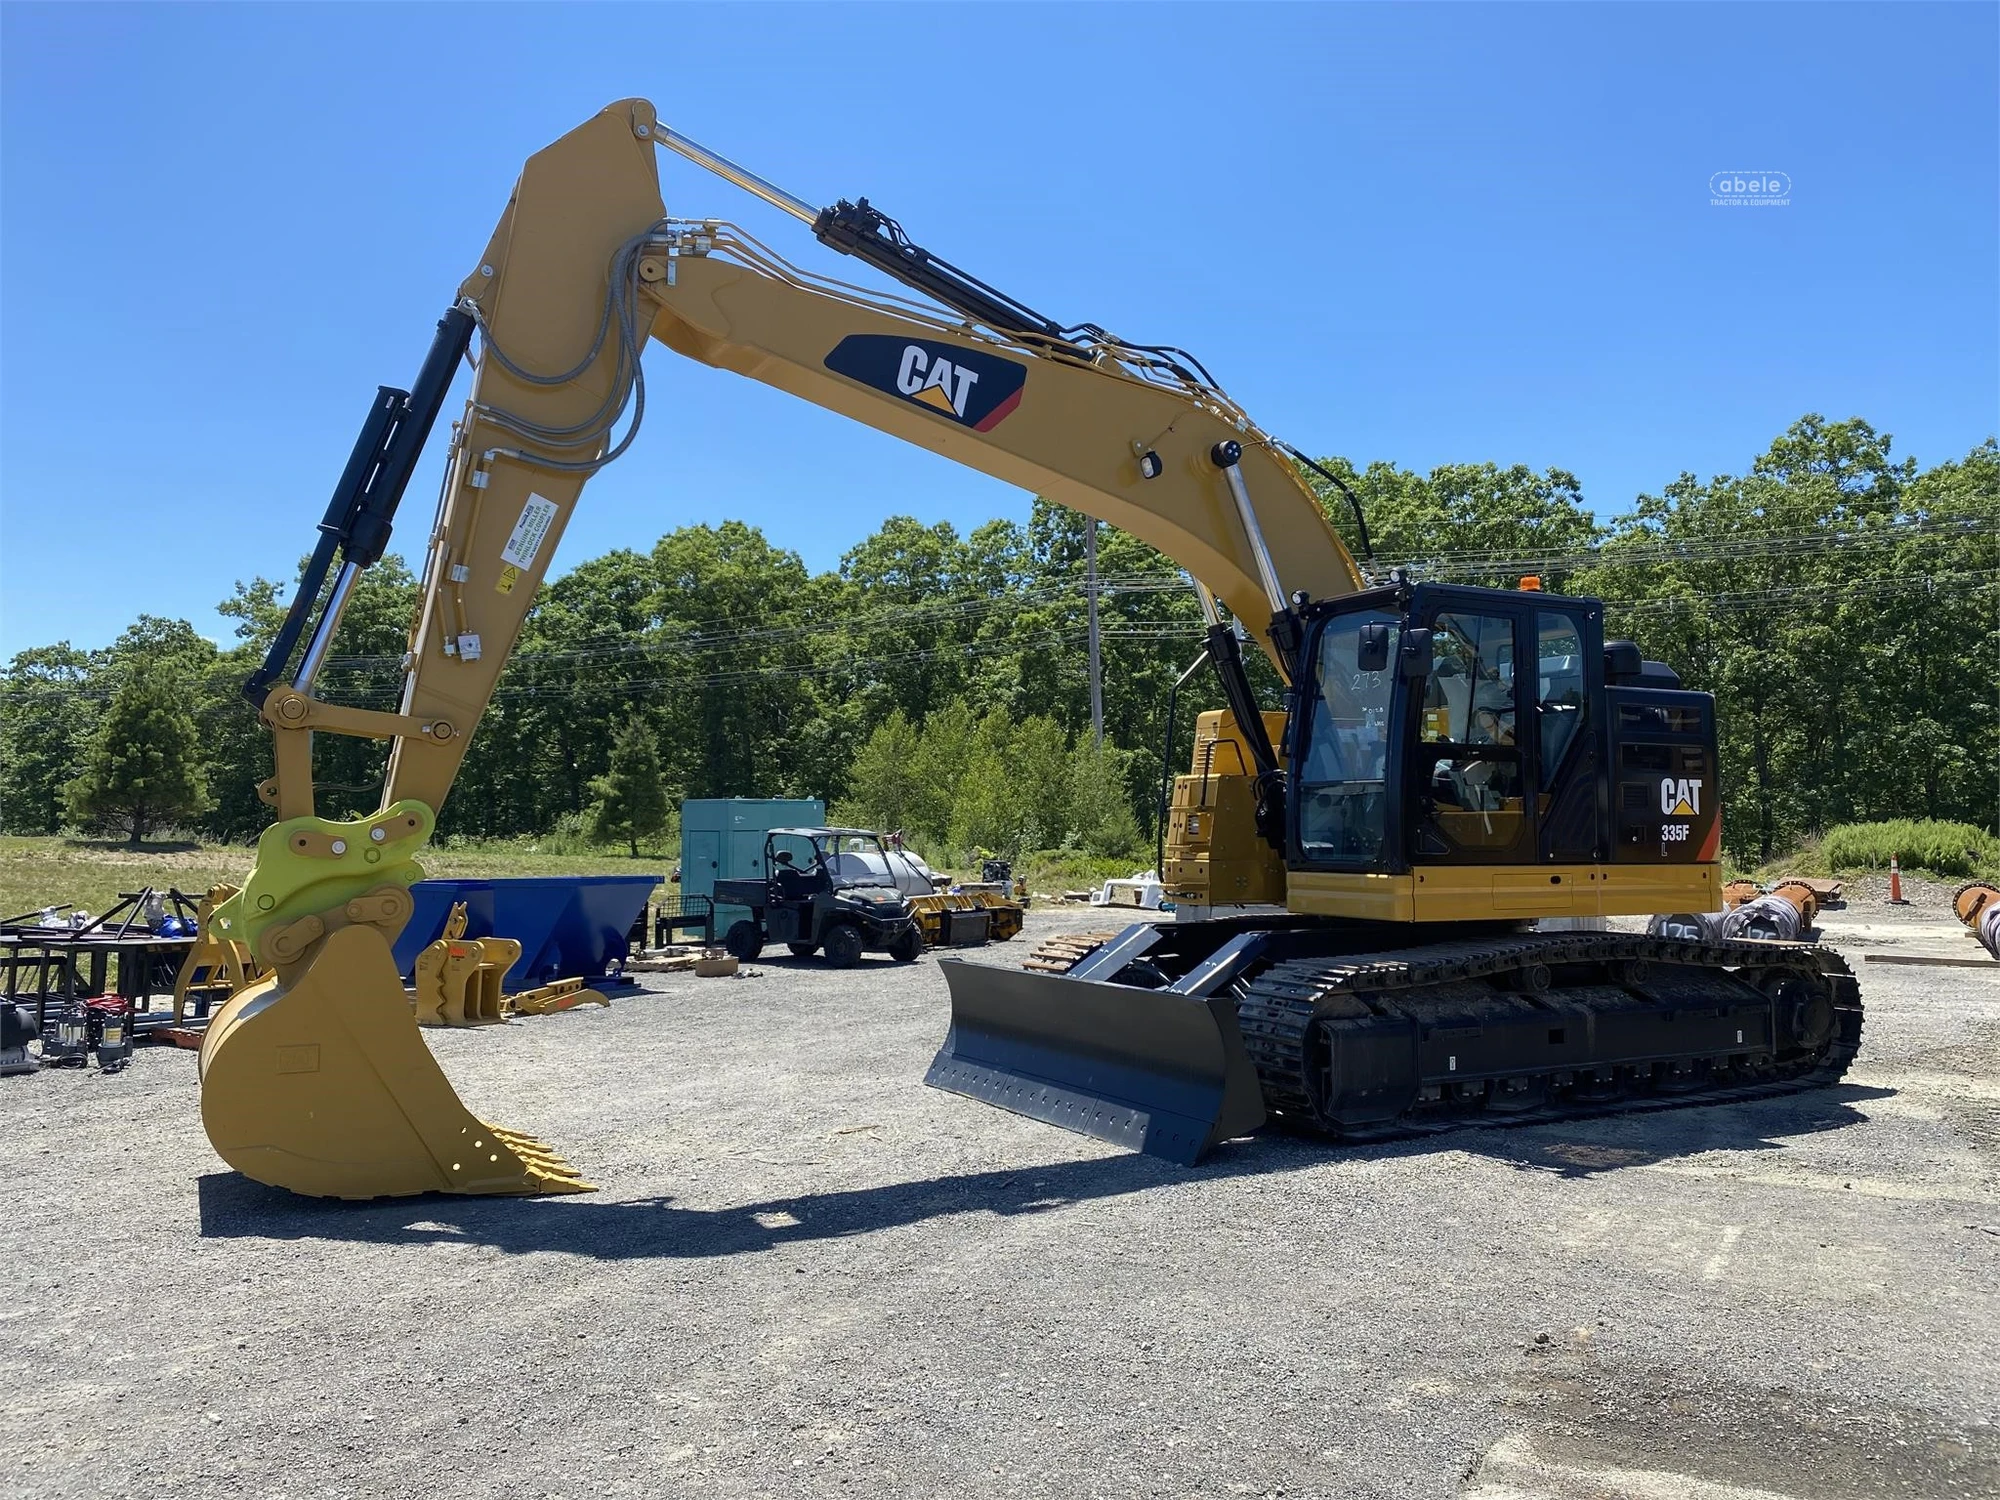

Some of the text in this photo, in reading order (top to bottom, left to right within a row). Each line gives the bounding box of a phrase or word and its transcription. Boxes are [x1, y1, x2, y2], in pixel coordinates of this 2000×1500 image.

[896, 344, 979, 418] CAT
[515, 528, 531, 556] GENUINE
[529, 506, 542, 528] MILLER
[518, 532, 537, 563] TWINLOCK
[534, 504, 551, 532] COUPLER
[1350, 670, 1381, 691] 273
[1660, 777, 1703, 816] CAT
[1661, 824, 1690, 842] 335F
[1661, 842, 1668, 857] L
